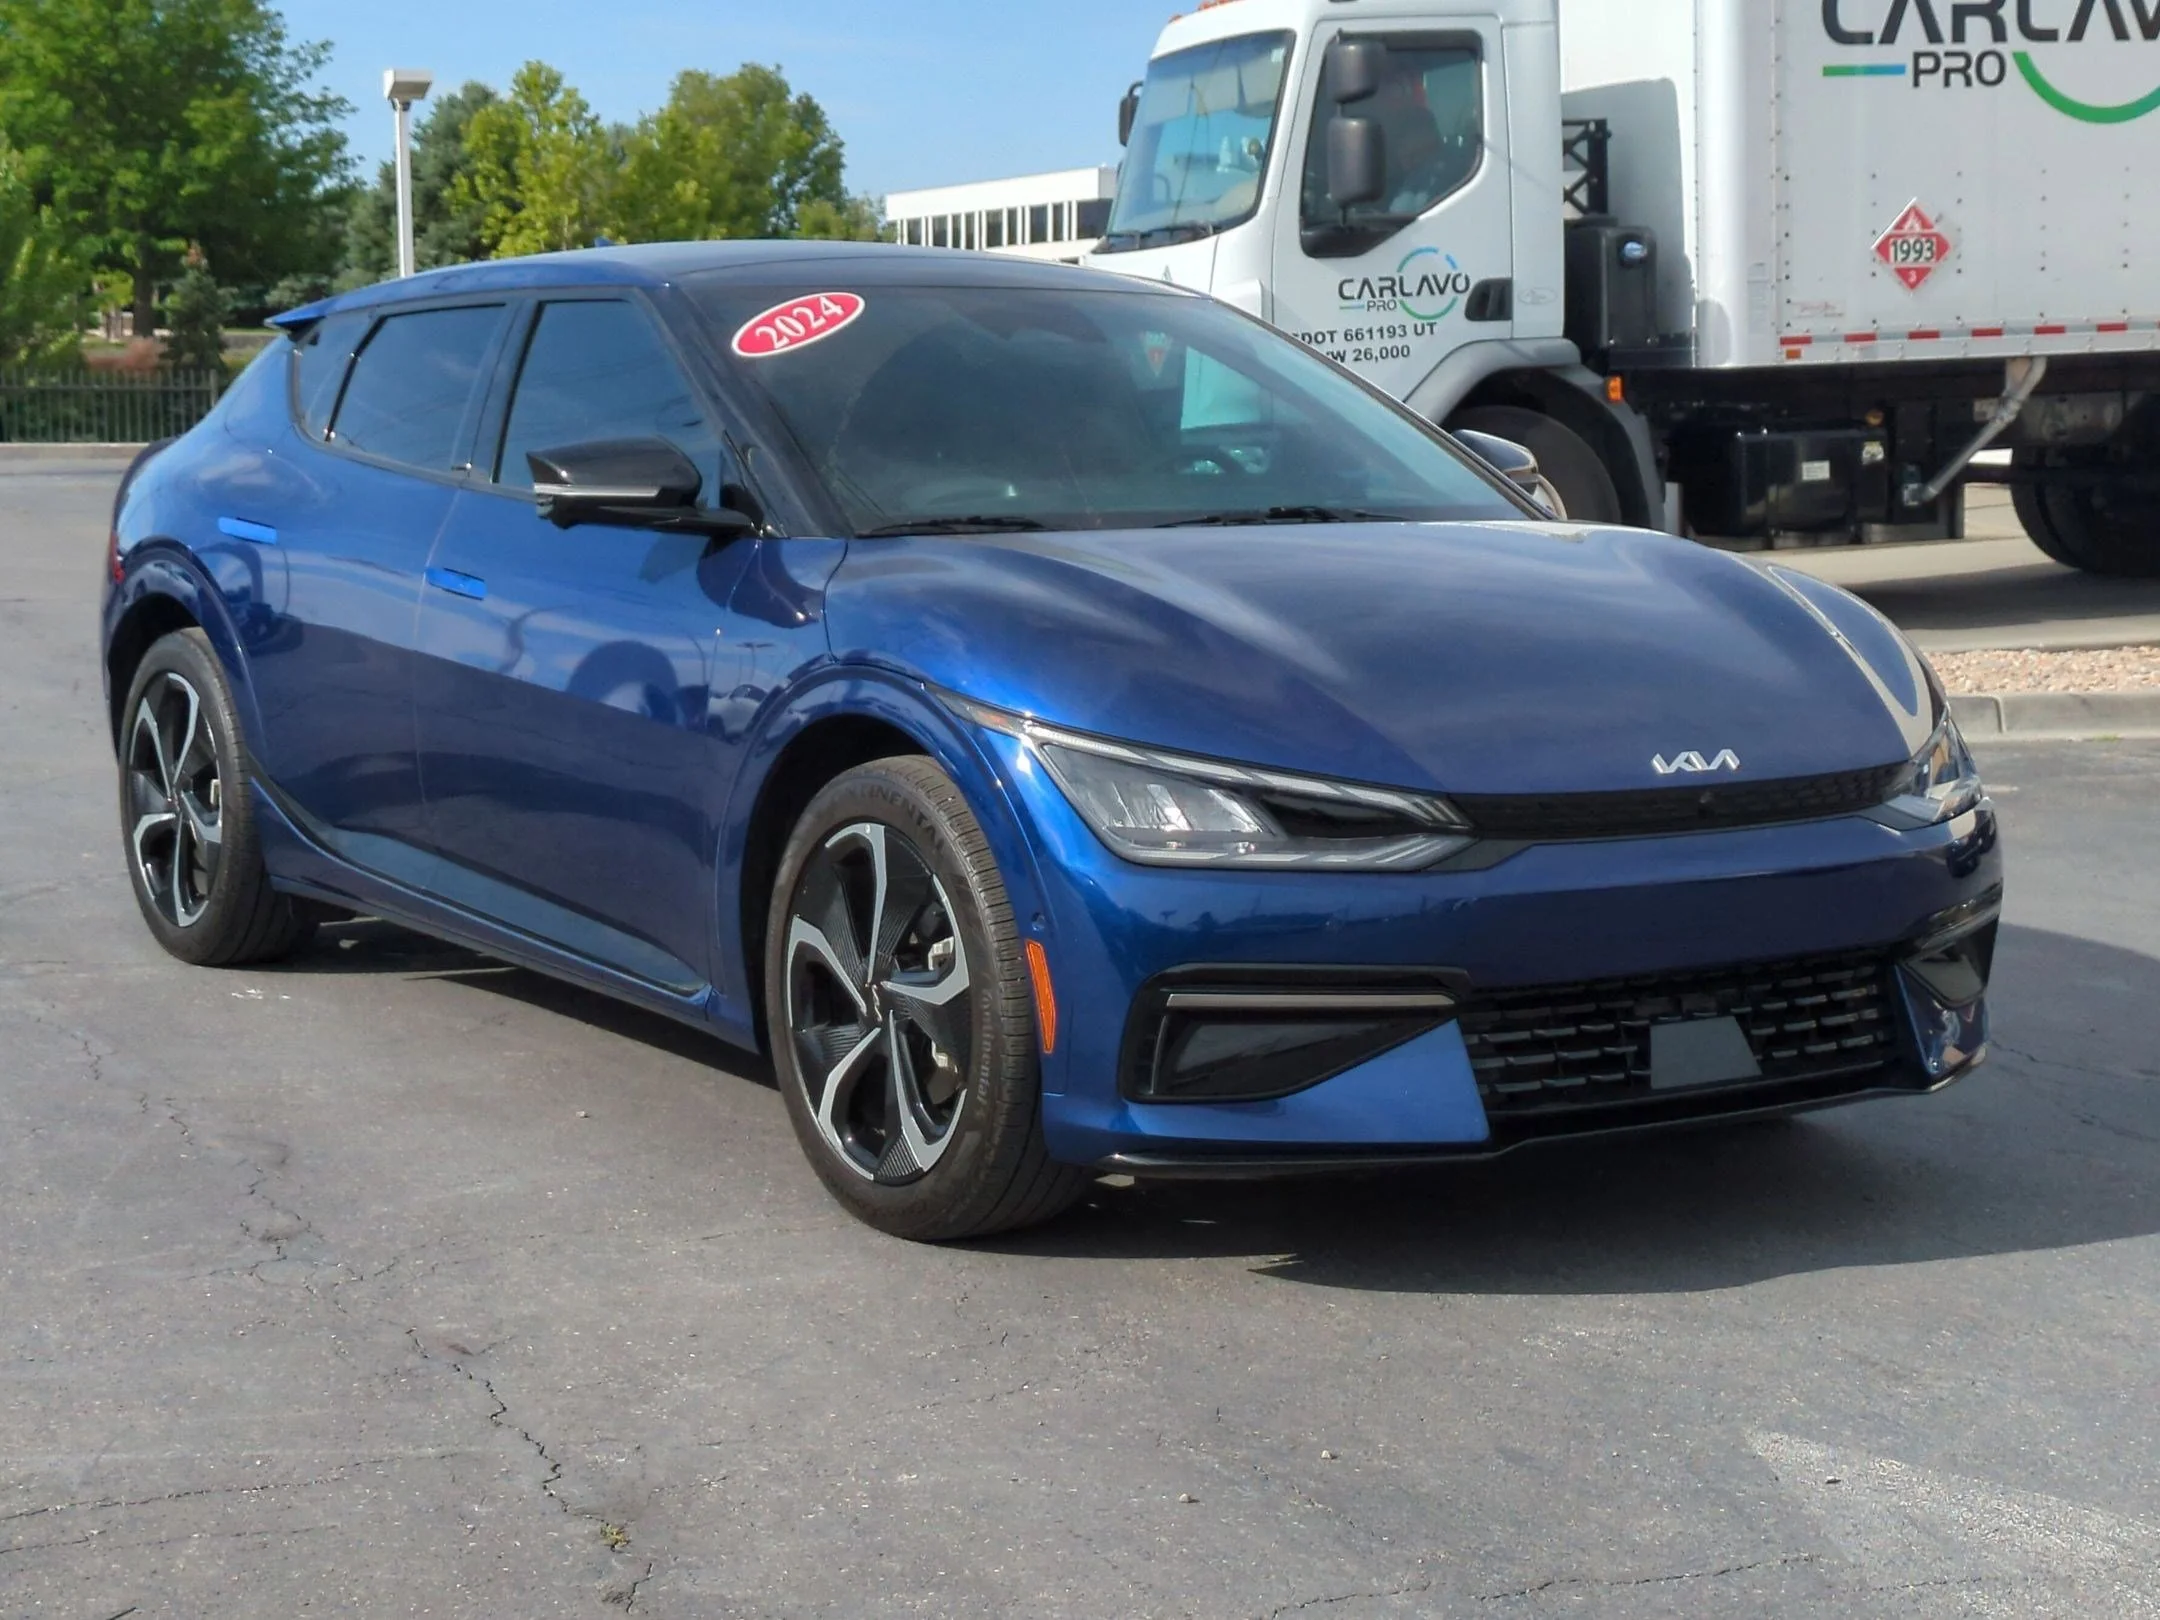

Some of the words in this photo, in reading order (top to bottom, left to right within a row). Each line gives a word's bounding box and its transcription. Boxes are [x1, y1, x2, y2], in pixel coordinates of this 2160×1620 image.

[1912, 50, 2006, 88] PRO
[1892, 239, 1935, 262] 1993
[1338, 272, 1471, 300] CARLAVO
[1908, 269, 1917, 283] 3
[1366, 299, 1397, 312] PRO
[755, 296, 845, 349] 2024
[1292, 330, 1337, 345] DOT
[1344, 324, 1407, 342] 661193
[1413, 322, 1437, 336] UT
[1326, 350, 1347, 363] W
[1353, 345, 1410, 364] 26,000
[1651, 748, 1740, 774] KIA
